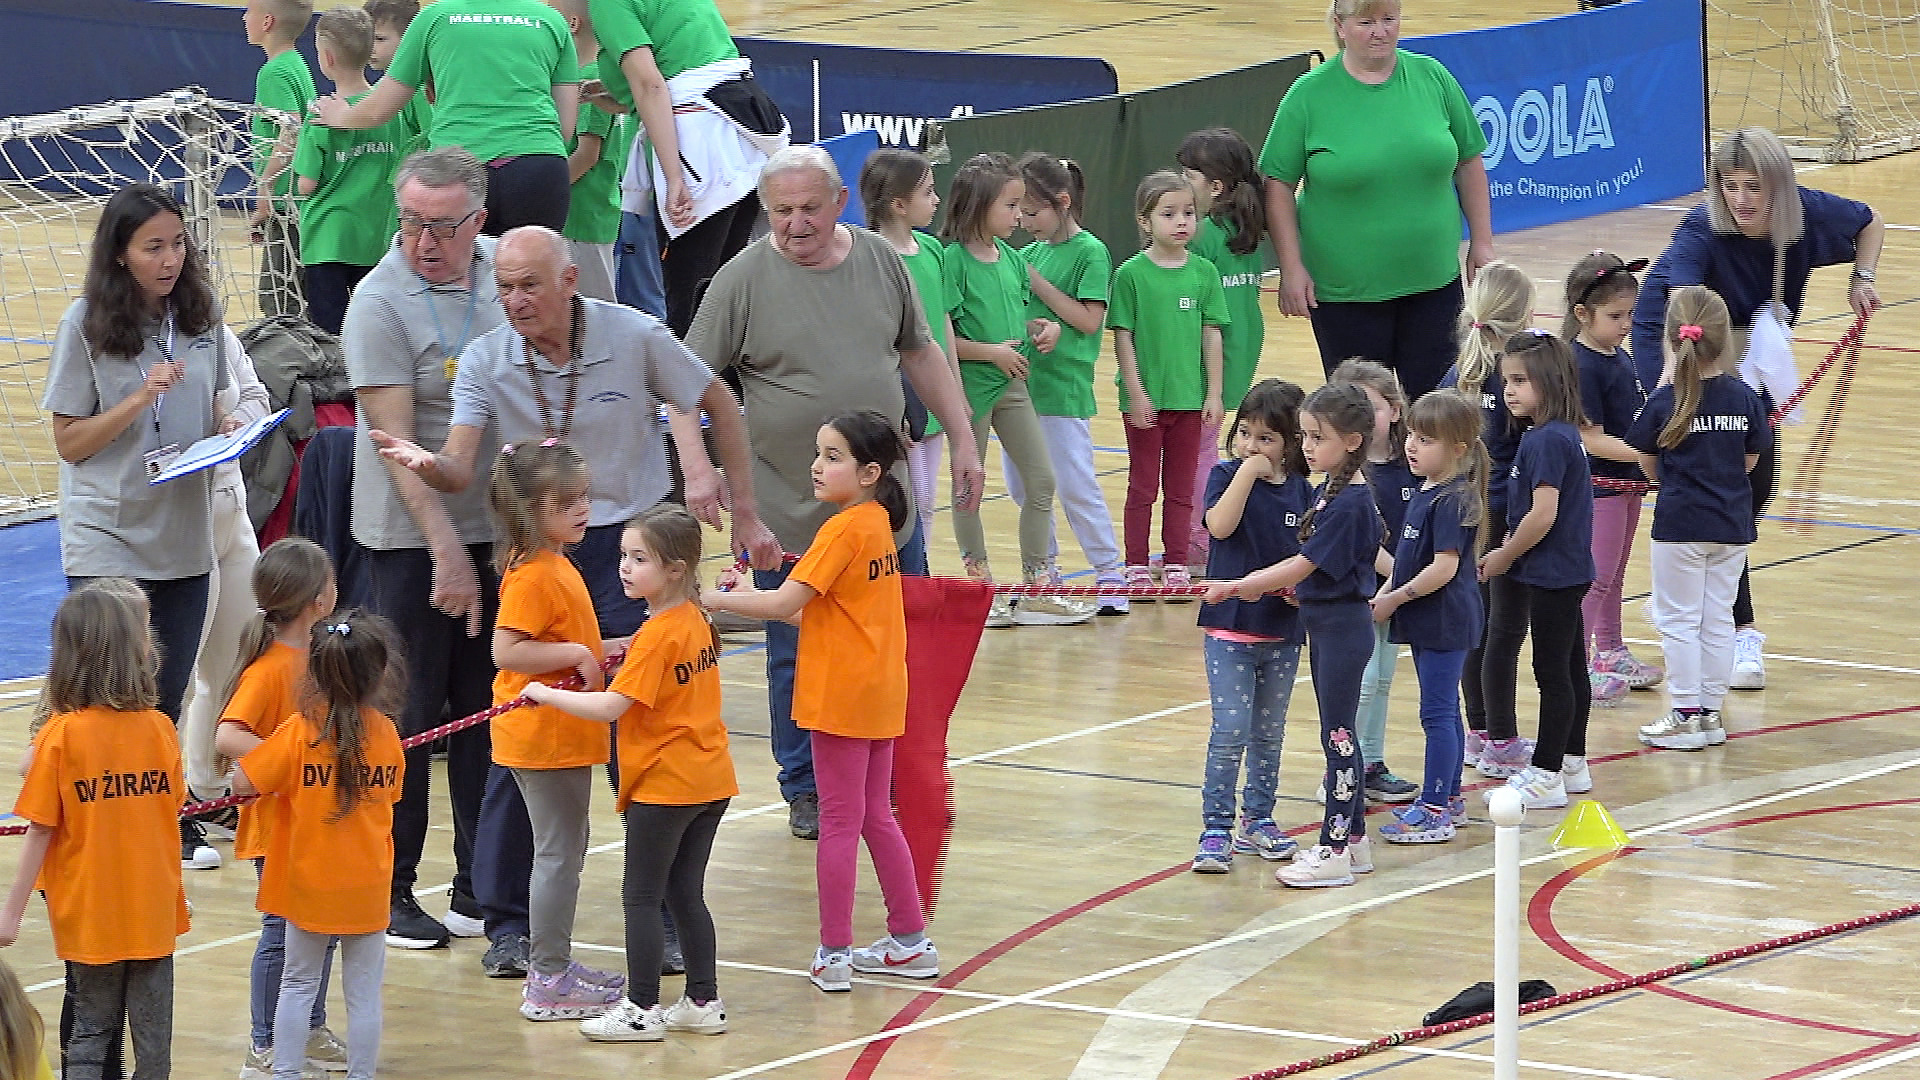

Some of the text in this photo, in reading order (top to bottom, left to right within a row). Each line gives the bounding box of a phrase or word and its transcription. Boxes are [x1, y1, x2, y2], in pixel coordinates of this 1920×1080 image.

[449, 13, 534, 27] MAESTRAL
[1471, 77, 1616, 171] OOLA
[1490, 157, 1645, 204] the Champion in you!
[1714, 415, 1750, 432] PRINC
[74, 769, 172, 803] DV ŽIRAFA
[303, 763, 333, 788] DV
